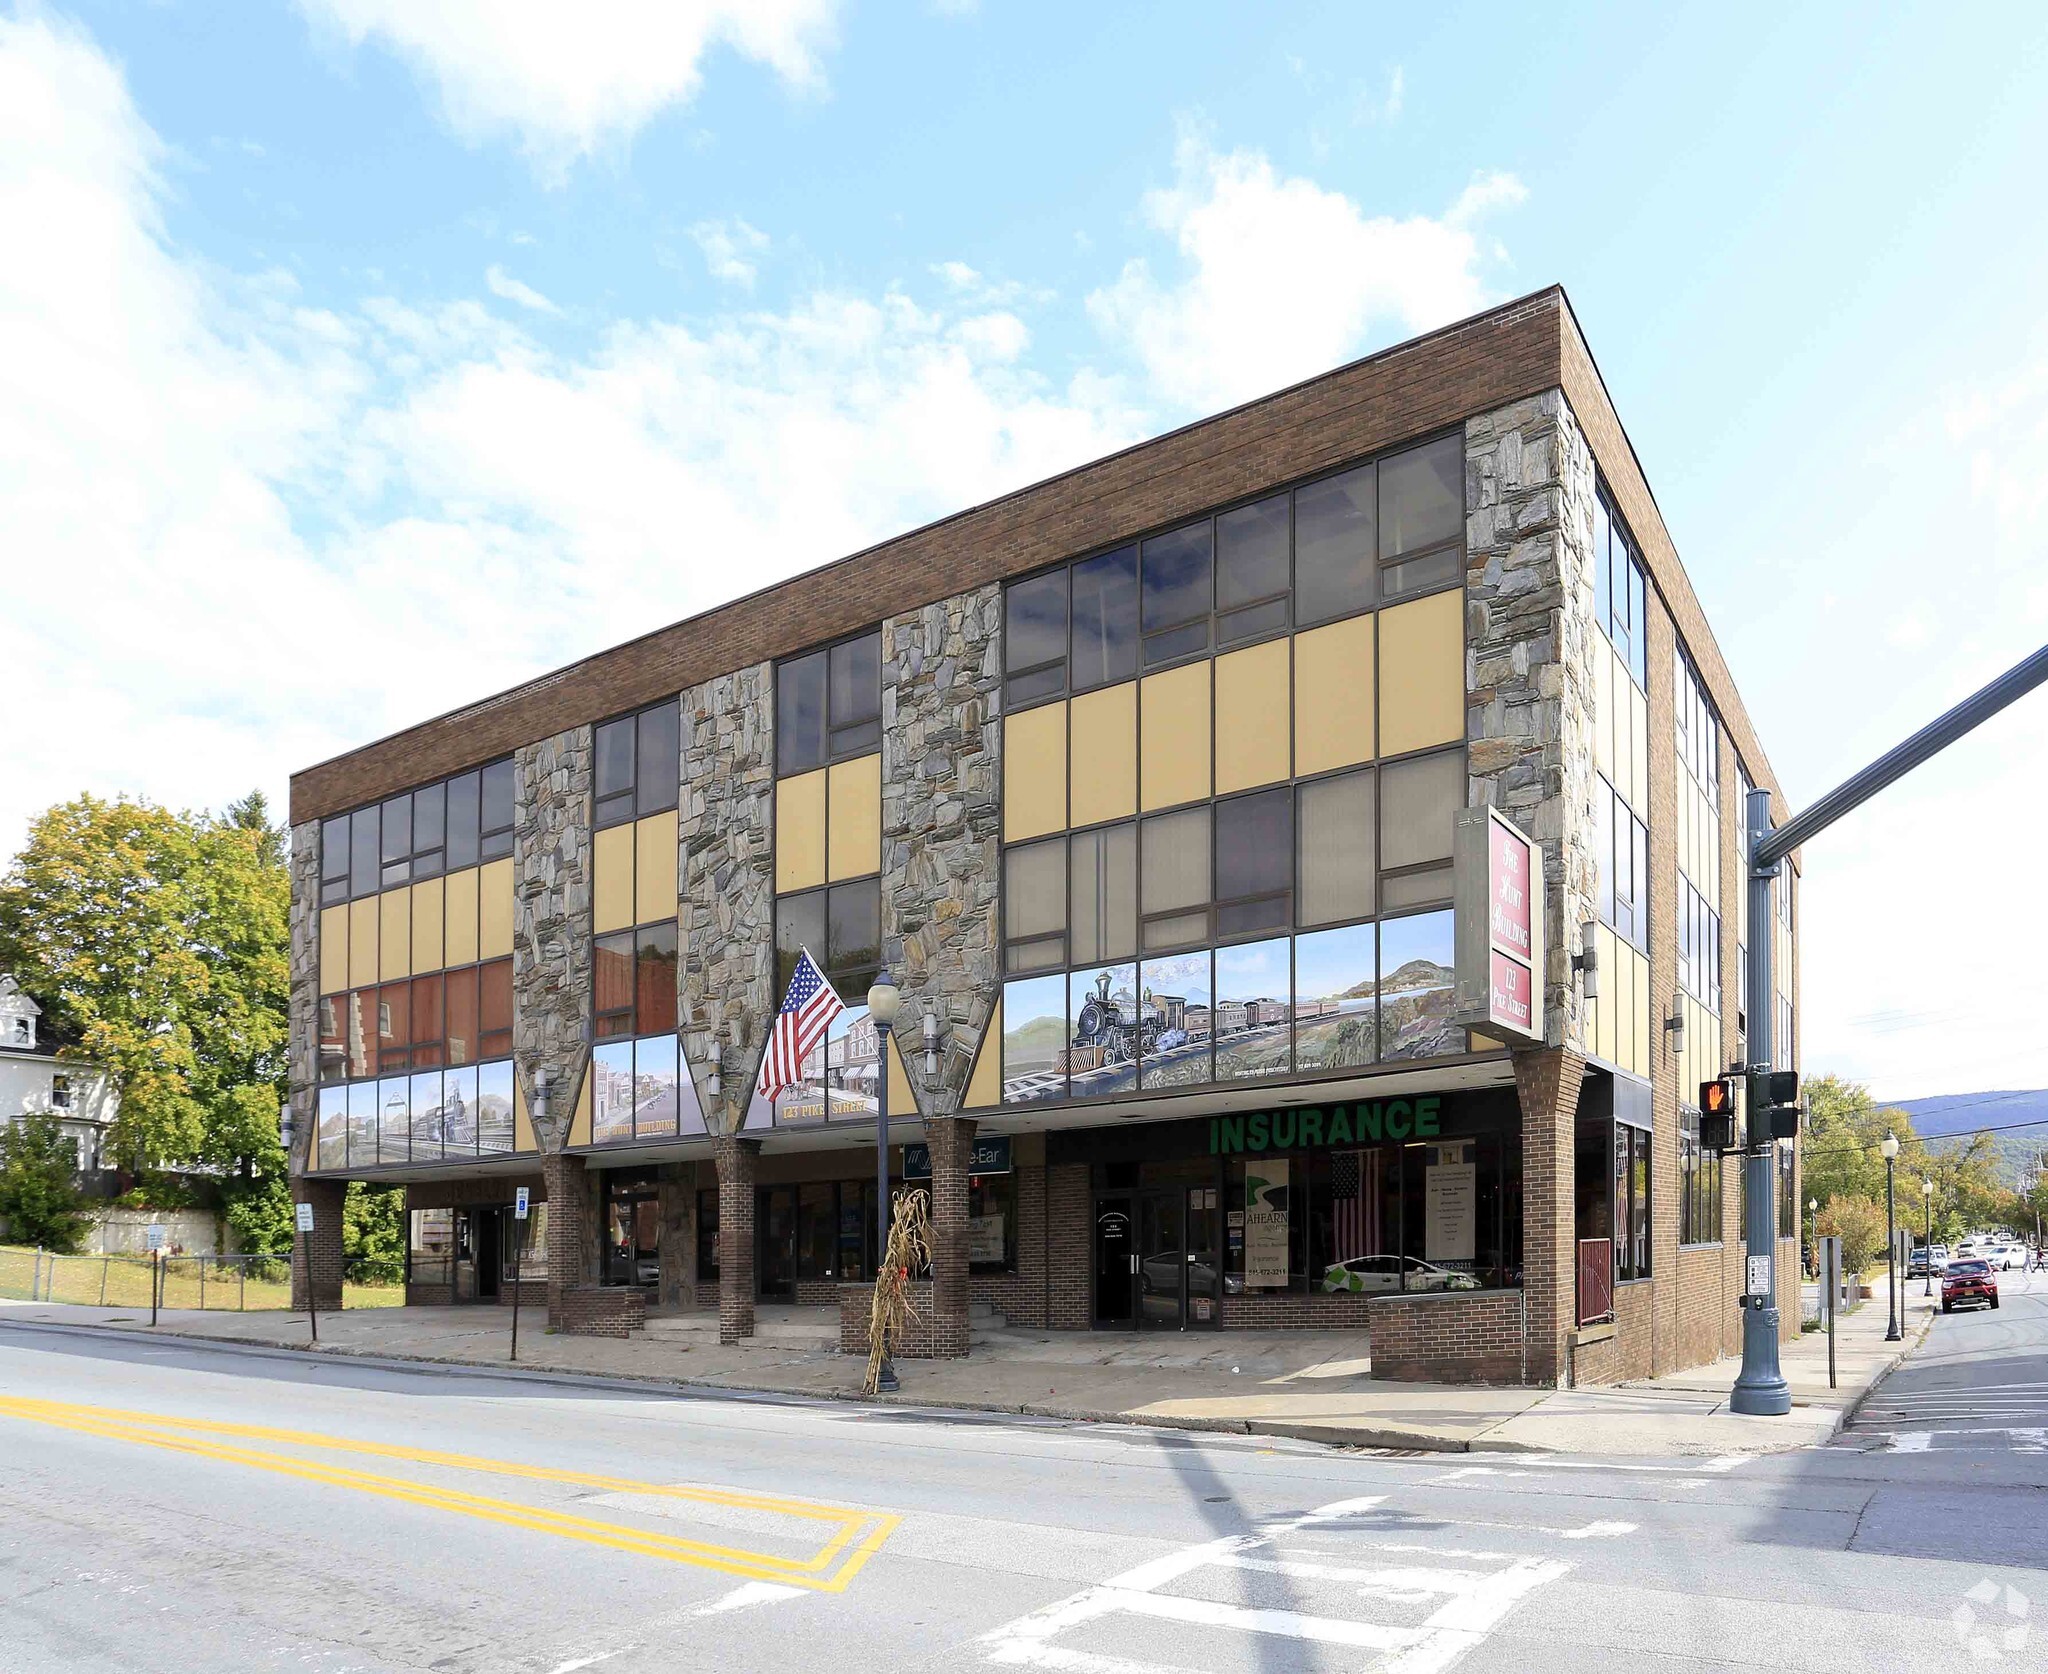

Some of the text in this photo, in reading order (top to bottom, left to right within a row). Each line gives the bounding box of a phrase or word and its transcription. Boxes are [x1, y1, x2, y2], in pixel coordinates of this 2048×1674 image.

[1504, 966, 1517, 991] 123
[783, 1106, 799, 1120] 123
[801, 1103, 825, 1118] PIKE
[1209, 1097, 1442, 1155] INSURANCE
[1246, 1212, 1288, 1225] AHEARN
